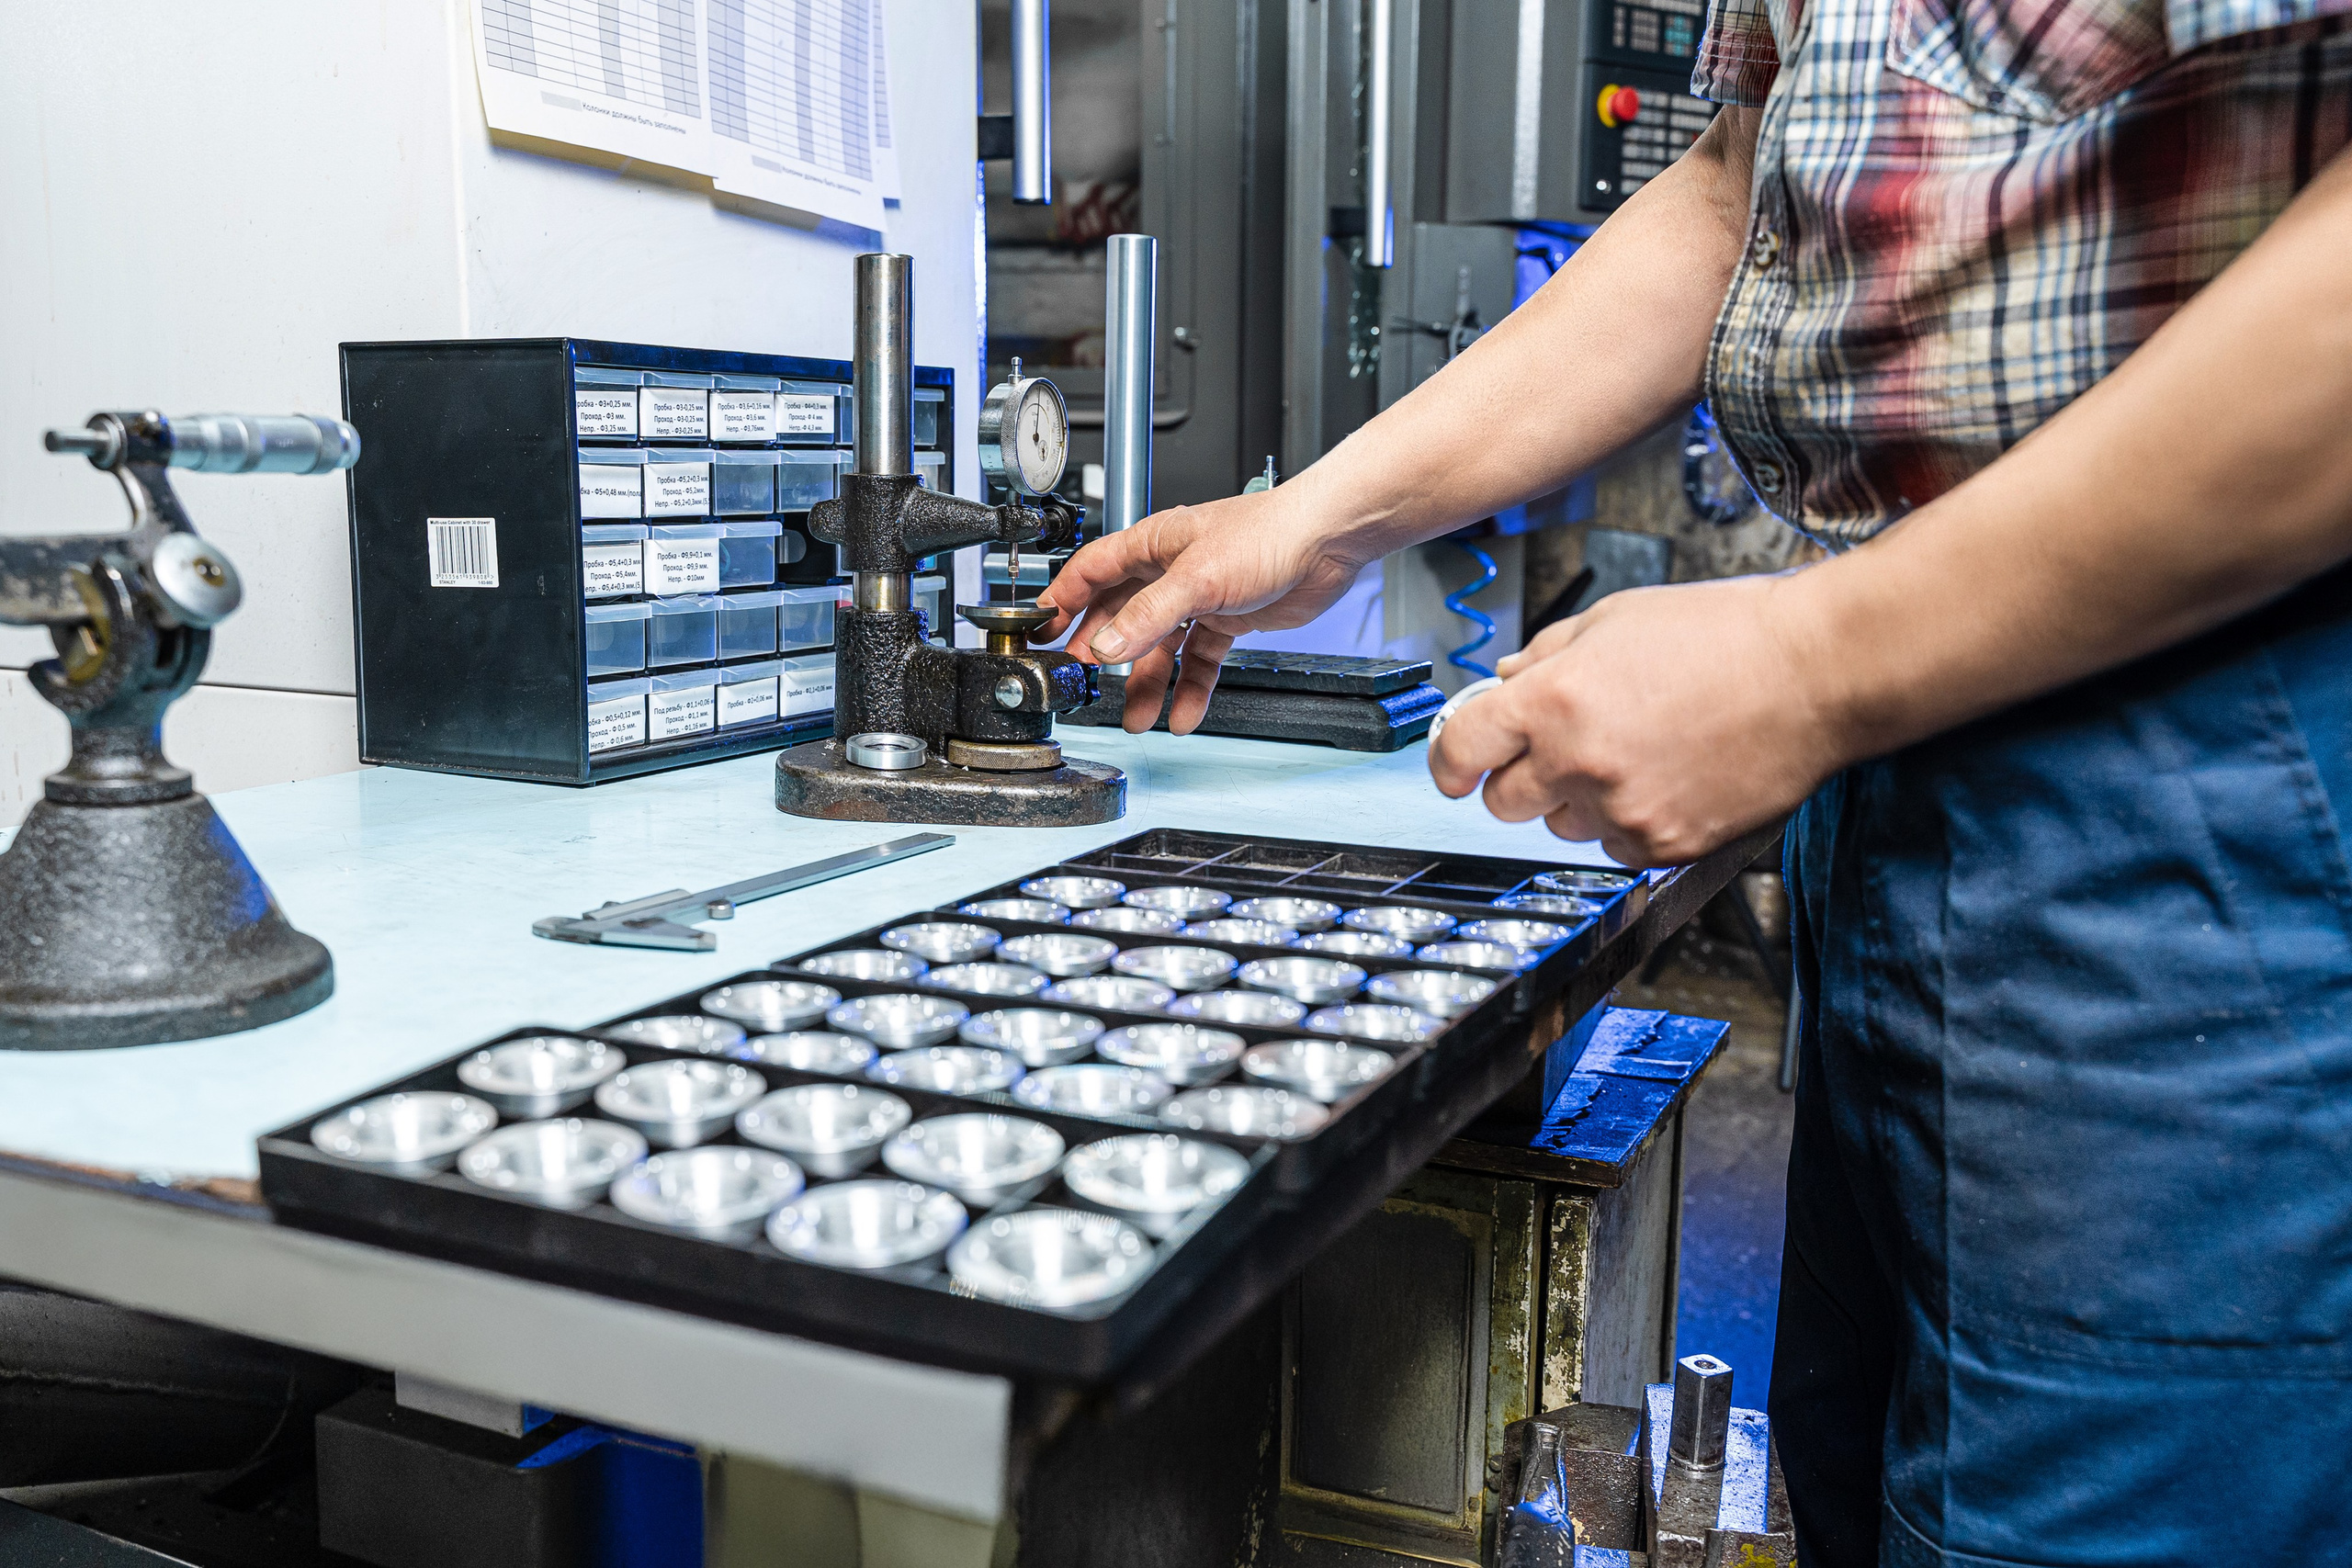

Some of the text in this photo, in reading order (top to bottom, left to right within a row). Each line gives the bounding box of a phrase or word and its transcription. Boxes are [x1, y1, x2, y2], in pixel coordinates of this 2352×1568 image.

[577, 400, 594, 409] робка
[598, 400, 621, 408] Ф3+0,25
[581, 412, 602, 421] Проход
[657, 476, 676, 485] Пробка
[608, 558, 632, 567] Ф5,4+0,3
[666, 704, 683, 713] резьбу
[605, 711, 631, 722] Ф0,5+0,12
